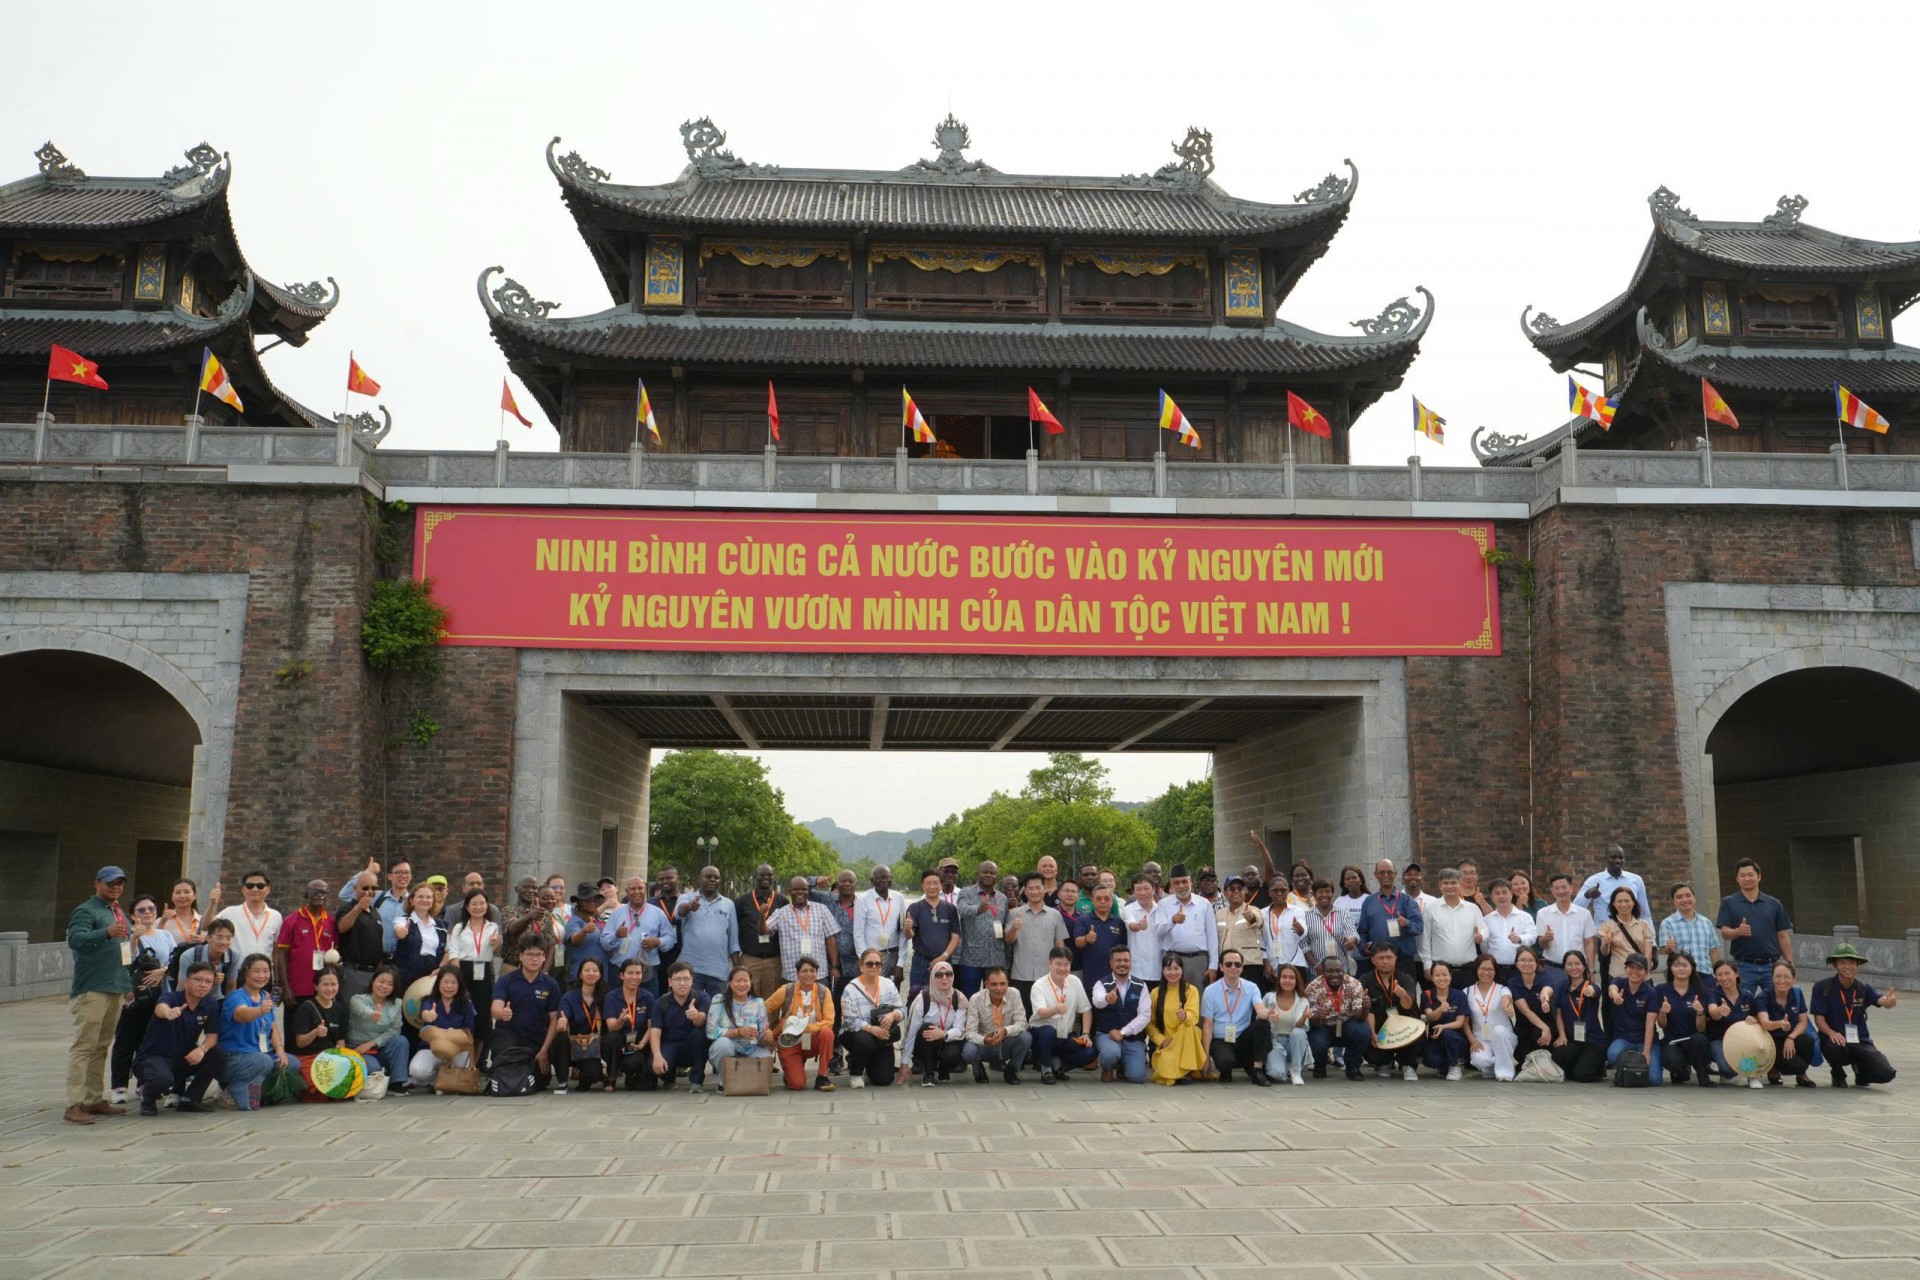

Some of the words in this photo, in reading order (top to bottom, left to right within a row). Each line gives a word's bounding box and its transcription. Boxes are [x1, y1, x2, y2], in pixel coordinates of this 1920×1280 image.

[535, 538, 617, 574] NINH
[628, 534, 706, 575] BÌNH
[717, 536, 806, 577] CÙNG
[817, 533, 860, 577] CẢ
[871, 537, 959, 578] NƯỚC
[969, 539, 1056, 580] BƯỚC
[1065, 540, 1128, 581] VÀO
[1137, 537, 1178, 582] KỶ
[1187, 542, 1314, 582] NGUYÊN
[1324, 543, 1384, 582] MỚI
[569, 582, 612, 628] KỶ
[621, 588, 754, 630] NGUYÊN
[764, 593, 853, 631] VƯƠN
[863, 590, 950, 632] MÌNH
[960, 587, 1025, 633] CỦA
[1034, 593, 1102, 634] DÂN
[1110, 593, 1170, 641] TỘC
[1180, 594, 1247, 642] VIỆT
[1255, 601, 1330, 635] NAM
[1341, 601, 1352, 634] !
